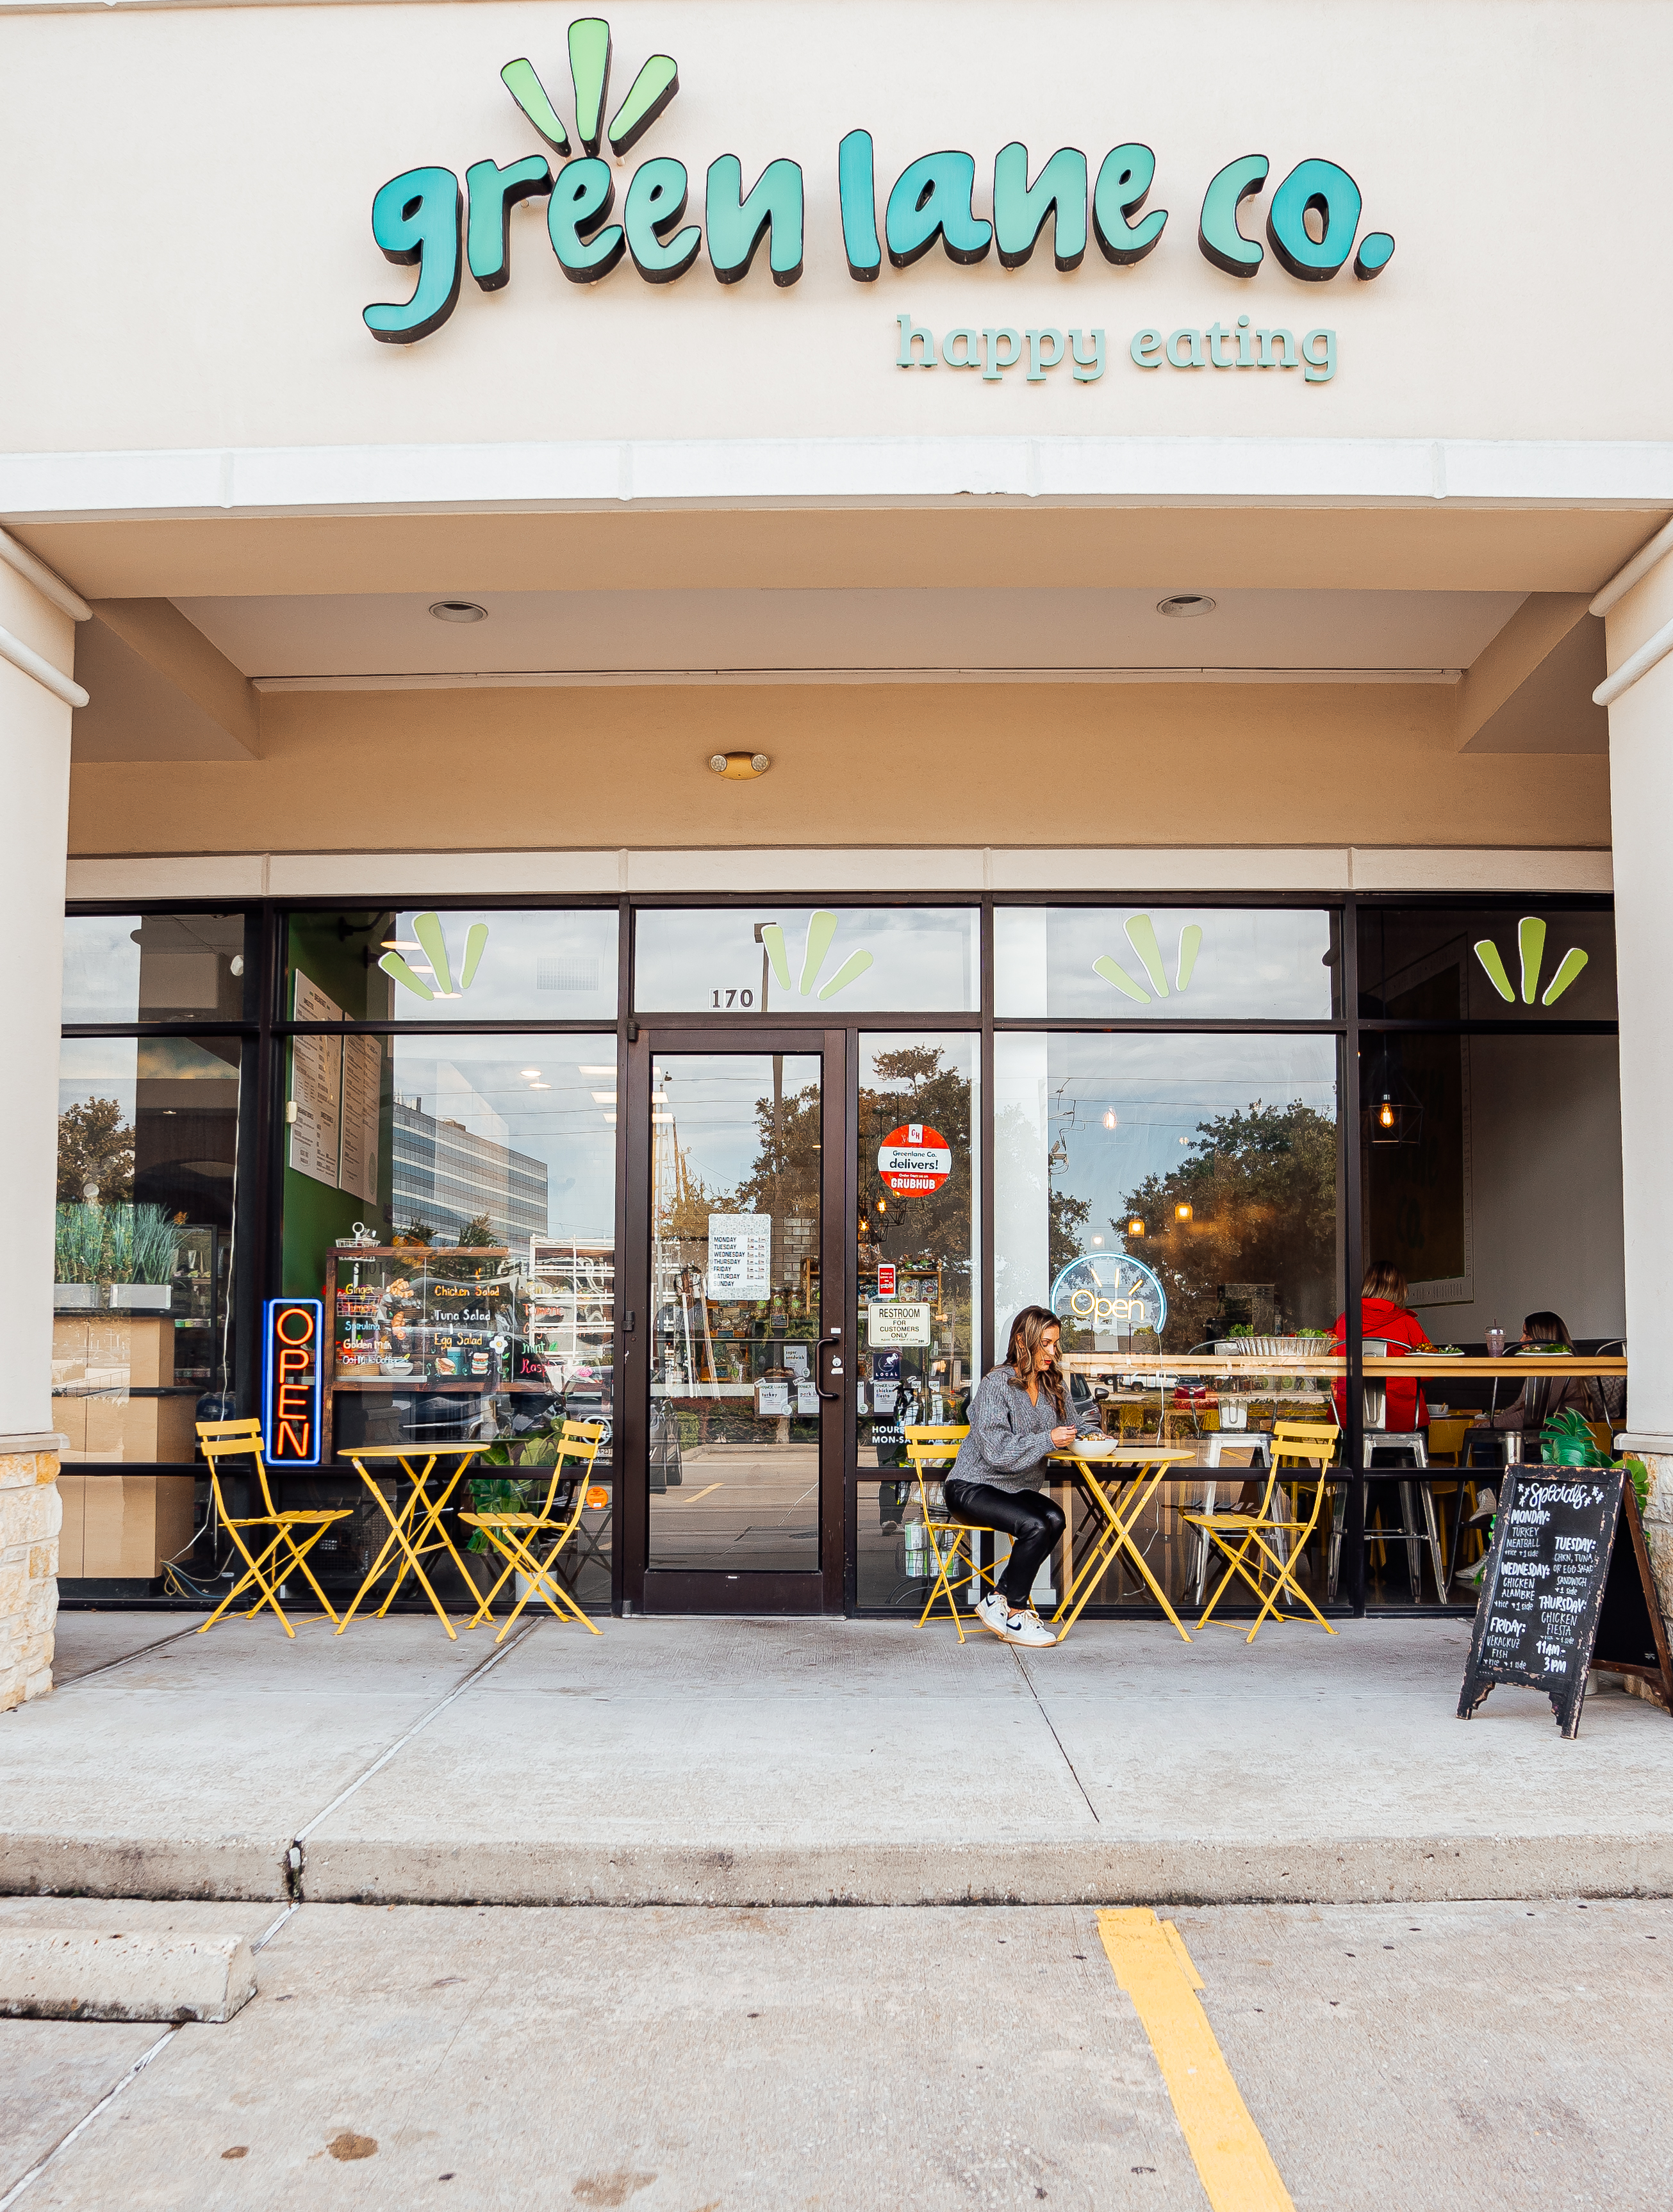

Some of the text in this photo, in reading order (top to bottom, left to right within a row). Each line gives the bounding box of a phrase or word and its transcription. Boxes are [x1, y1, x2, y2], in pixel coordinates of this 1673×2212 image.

[361, 128, 1396, 344] green lane co.
[897, 313, 1339, 383] happy eating
[713, 989, 754, 1008] 170
[889, 1158, 939, 1170] delivers!
[891, 1177, 935, 1190] GRUBHUB
[434, 1284, 500, 1297] Chicken Salad
[522, 1303, 565, 1316] Tmeric
[879, 1308, 920, 1318] RESTROOM
[1070, 1289, 1145, 1325] Open
[433, 1309, 491, 1321] Tuna Salad
[345, 1320, 381, 1331] Spirulina
[343, 1338, 373, 1350] Golden
[434, 1332, 482, 1350] Egg Salad
[276, 1307, 314, 1457] OPEN
[871, 1436, 912, 1444] MON-SA
[1529, 1482, 1587, 1510] Specials
[1511, 1509, 1551, 1525] MONDAY:
[1512, 1527, 1540, 1538] TURKEY
[1506, 1538, 1541, 1548] MEATBALL
[1554, 1536, 1597, 1553] TUESDAY:
[1500, 1561, 1551, 1580] WEDNESDAY:
[1553, 1564, 1562, 1574] OR
[1563, 1565, 1577, 1574] EGG
[1503, 1577, 1536, 1589] CHICKEN
[1556, 1575, 1588, 1587] SANDWICH
[1501, 1588, 1536, 1601] ALAMBRE
[1538, 1594, 1587, 1614] THURSDAY:
[1541, 1610, 1578, 1626] CHICKEN
[1490, 1616, 1526, 1638] FRIDAY:
[1546, 1623, 1572, 1636] FIESTA
[1491, 1648, 1508, 1659] FISH
